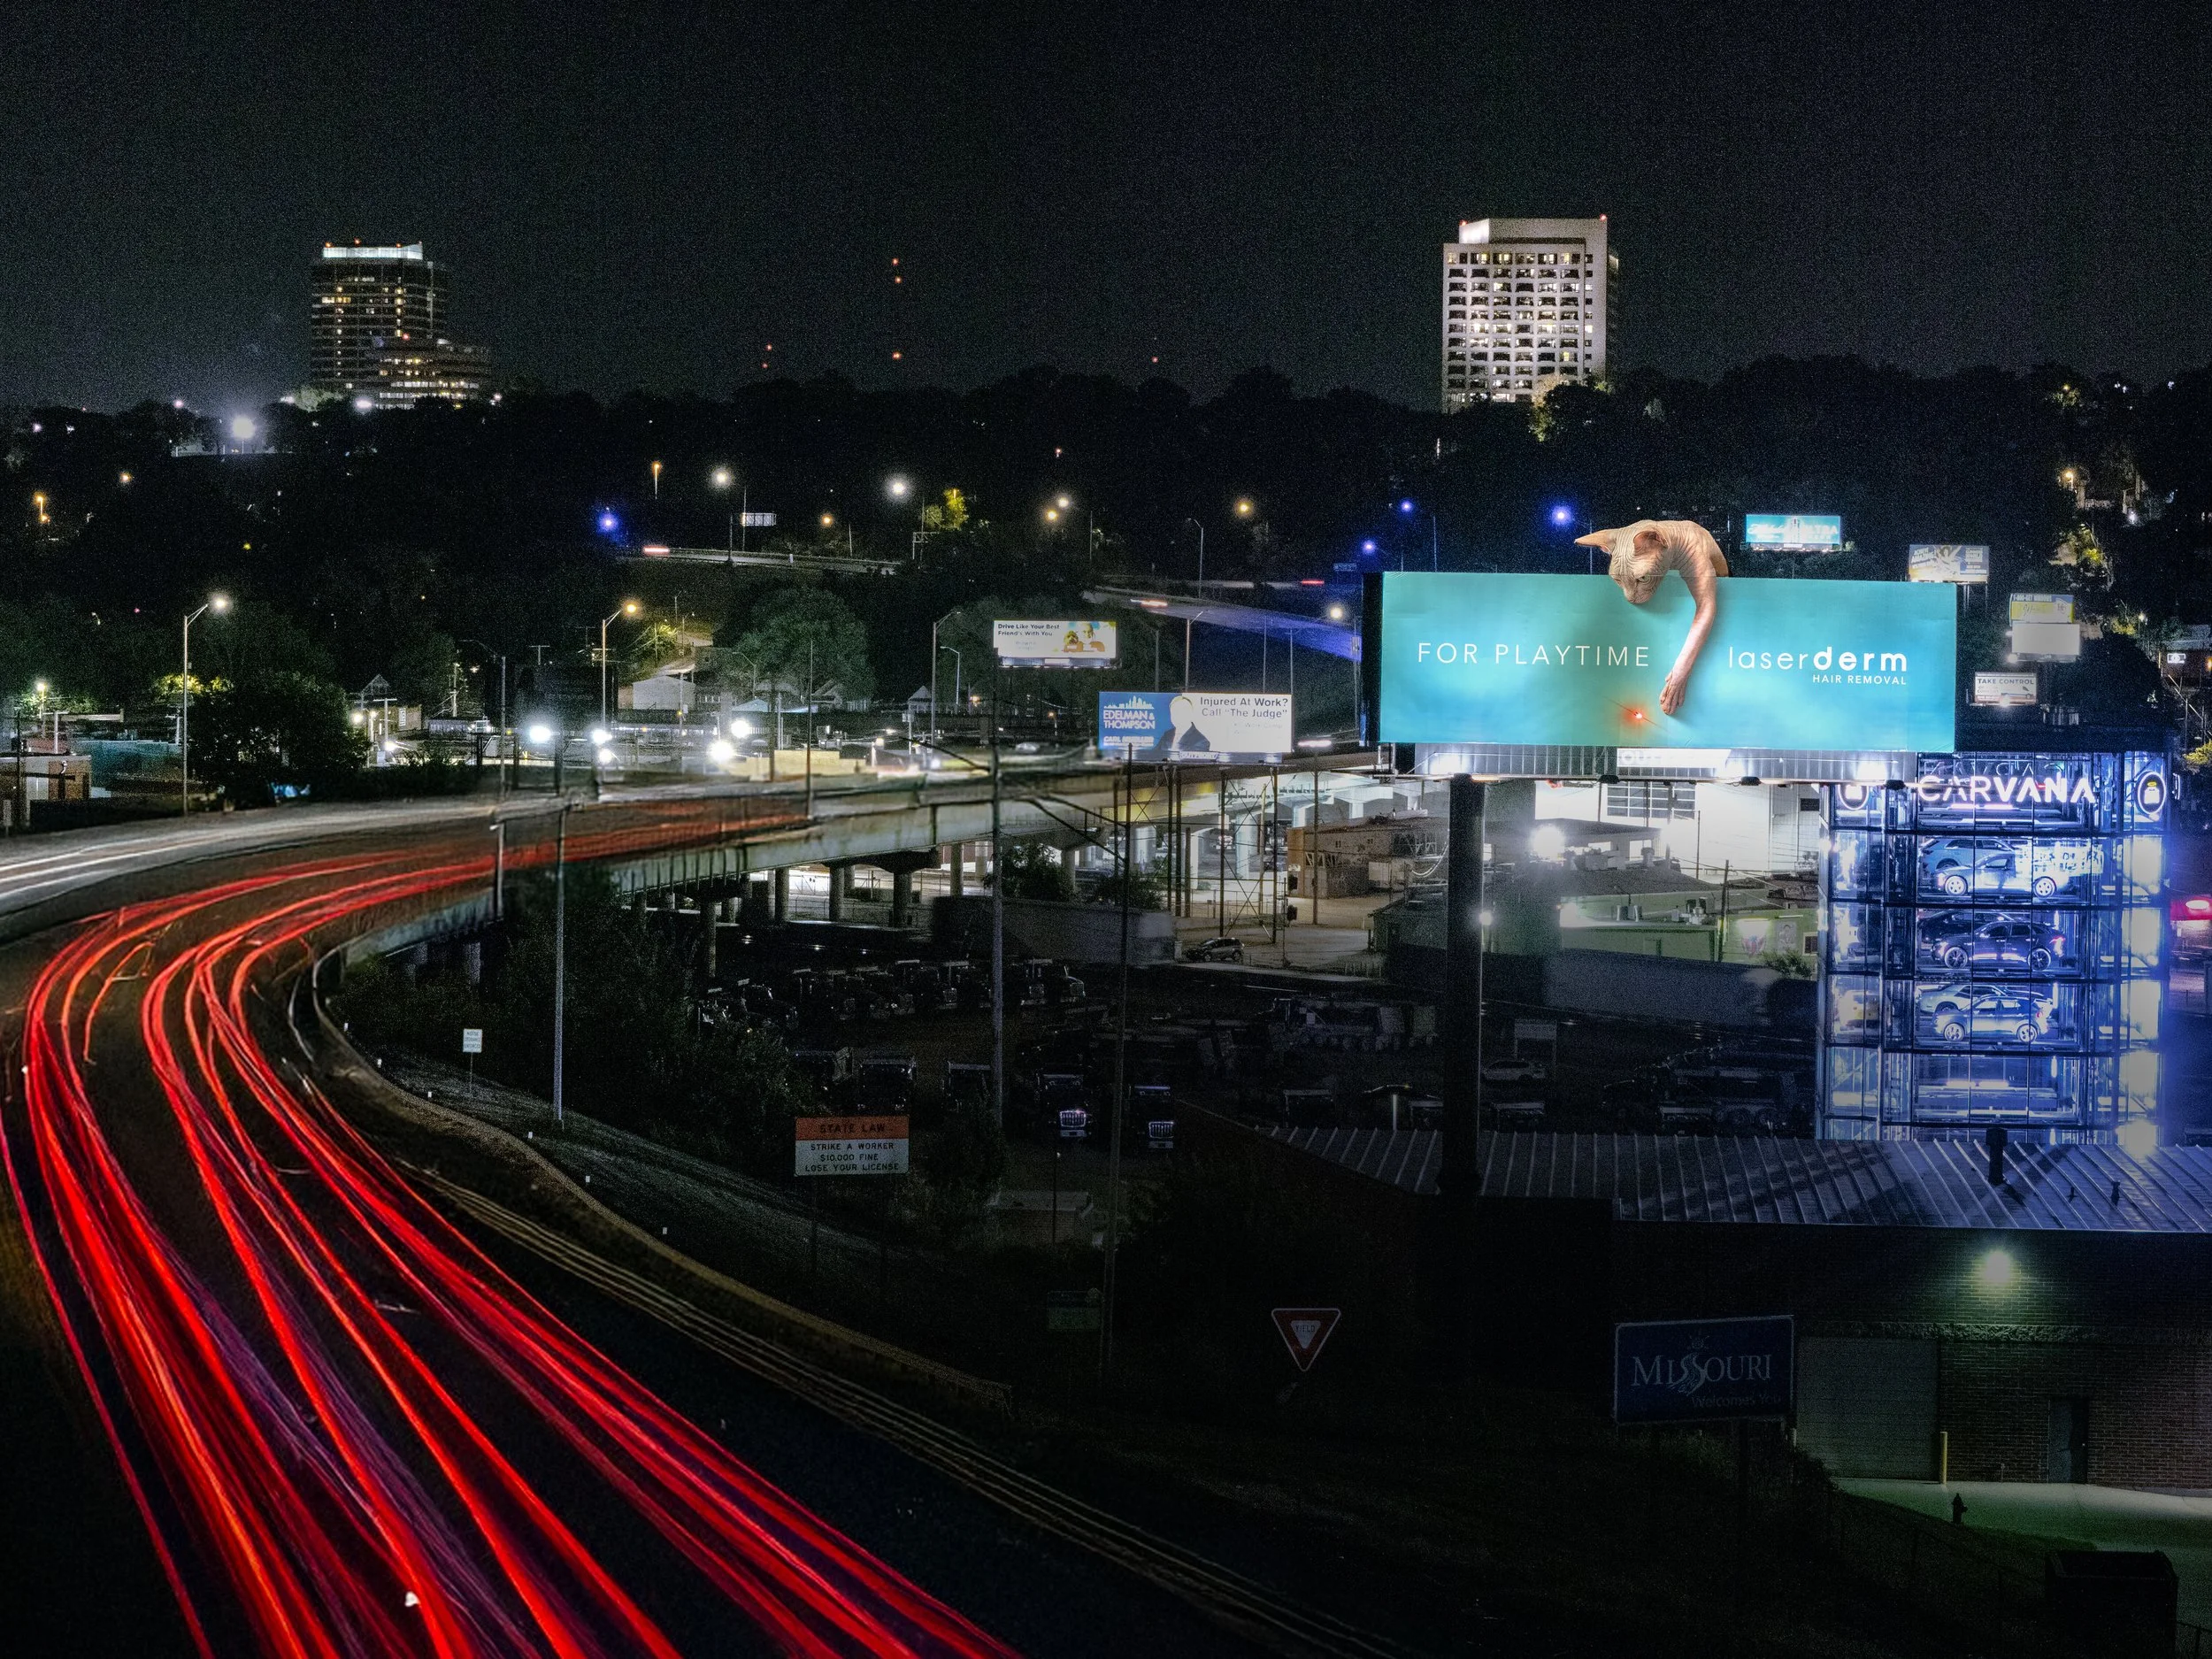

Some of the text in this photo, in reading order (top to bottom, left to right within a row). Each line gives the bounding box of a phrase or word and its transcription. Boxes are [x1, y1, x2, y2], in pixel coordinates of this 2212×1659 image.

[1417, 642, 1649, 666] FOR PLAYTIME
[1729, 646, 1907, 672] laserderm
[1813, 674, 1907, 685] HAIR REMOVAL
[1200, 696, 1288, 707] Injured At Work?
[1103, 710, 1148, 719] EDELMAN
[1103, 719, 1155, 729] THOMPSON
[1917, 775, 2096, 803] CARVANA
[820, 1123, 885, 1133] STATE LAW
